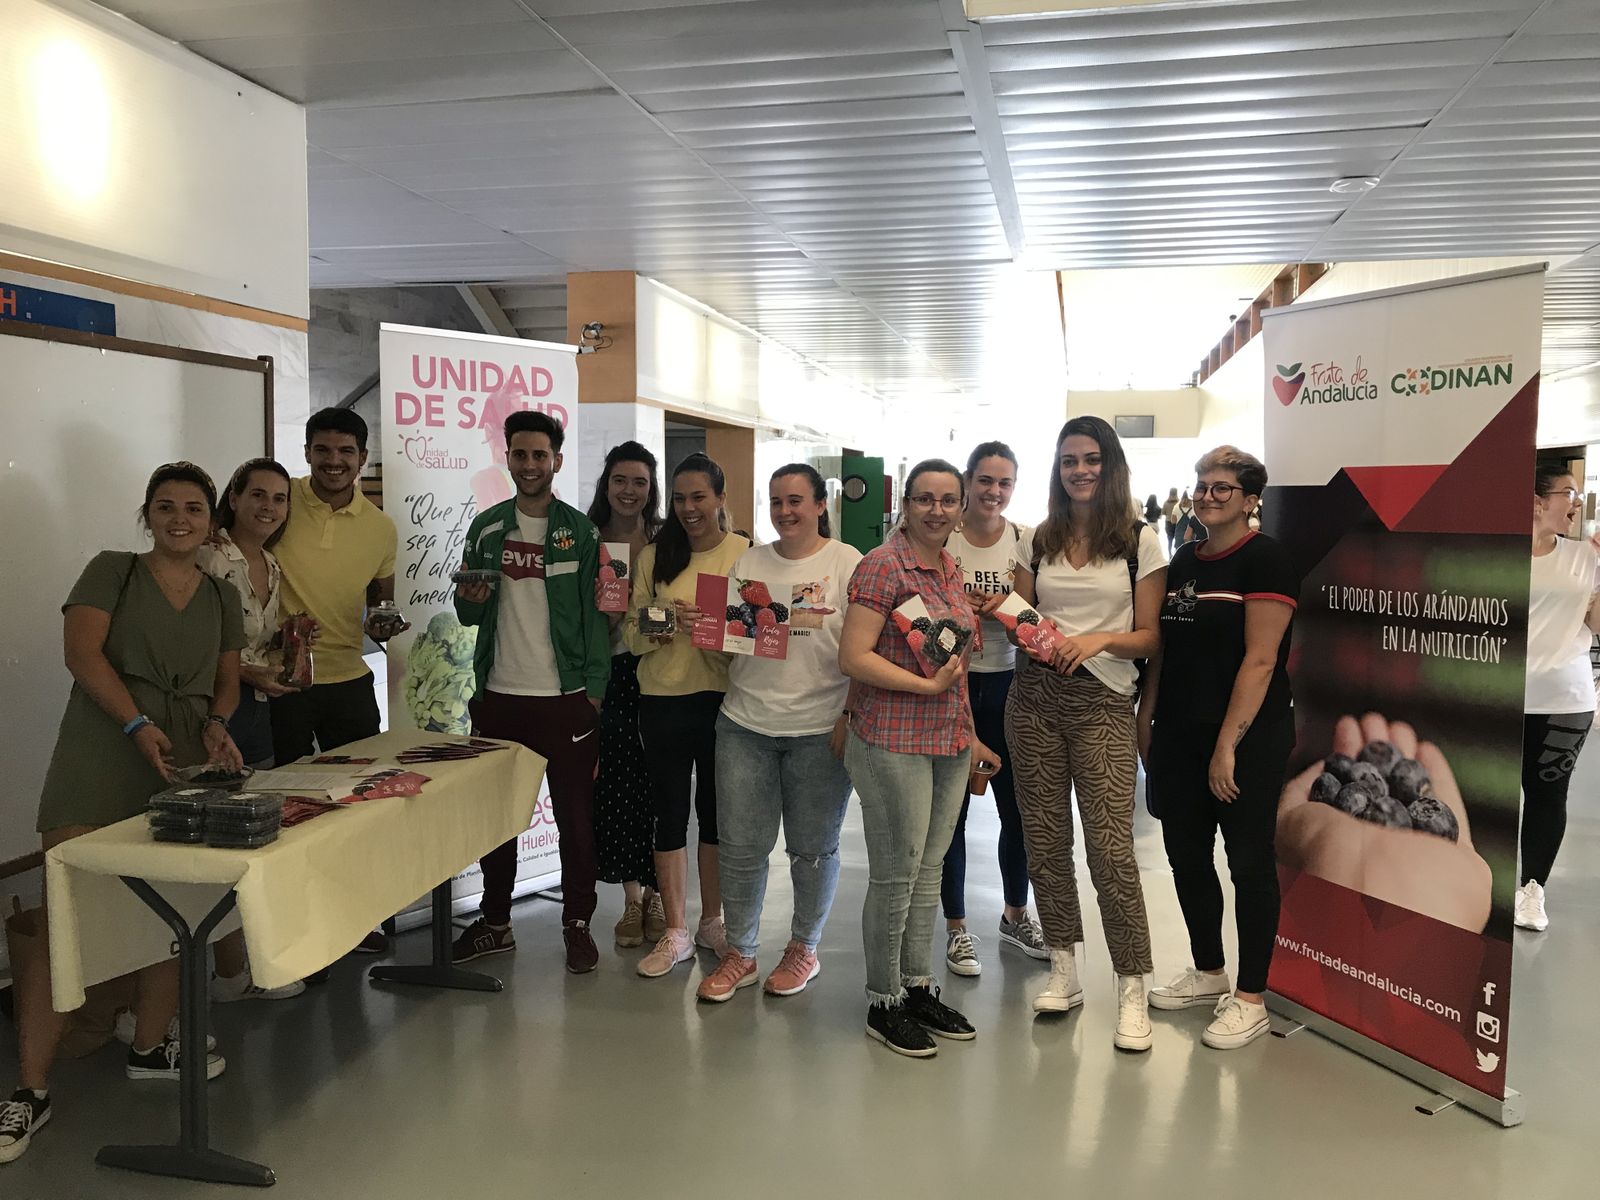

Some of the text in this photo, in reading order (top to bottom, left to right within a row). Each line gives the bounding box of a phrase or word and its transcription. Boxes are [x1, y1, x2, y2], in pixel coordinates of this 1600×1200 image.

[412, 354, 553, 397] UNIDAD
[1310, 355, 1368, 386] Fruta de
[1300, 381, 1378, 405] Andalucía
[395, 392, 445, 427] DE
[460, 495, 480, 524] tu
[406, 523, 465, 553] sea tu
[406, 550, 428, 580] el
[502, 549, 544, 569] evi's
[975, 571, 1001, 584] BEE
[1343, 586, 1375, 614] PODER
[1379, 589, 1393, 615] DE
[1397, 590, 1419, 618] LOS
[1423, 589, 1509, 627] ARÁNDANOS
[1382, 625, 1399, 651] EN
[1402, 626, 1417, 653] LA
[521, 830, 560, 852] Huelva
[1274, 933, 1462, 1023] ww.frutadeandalucia.com
